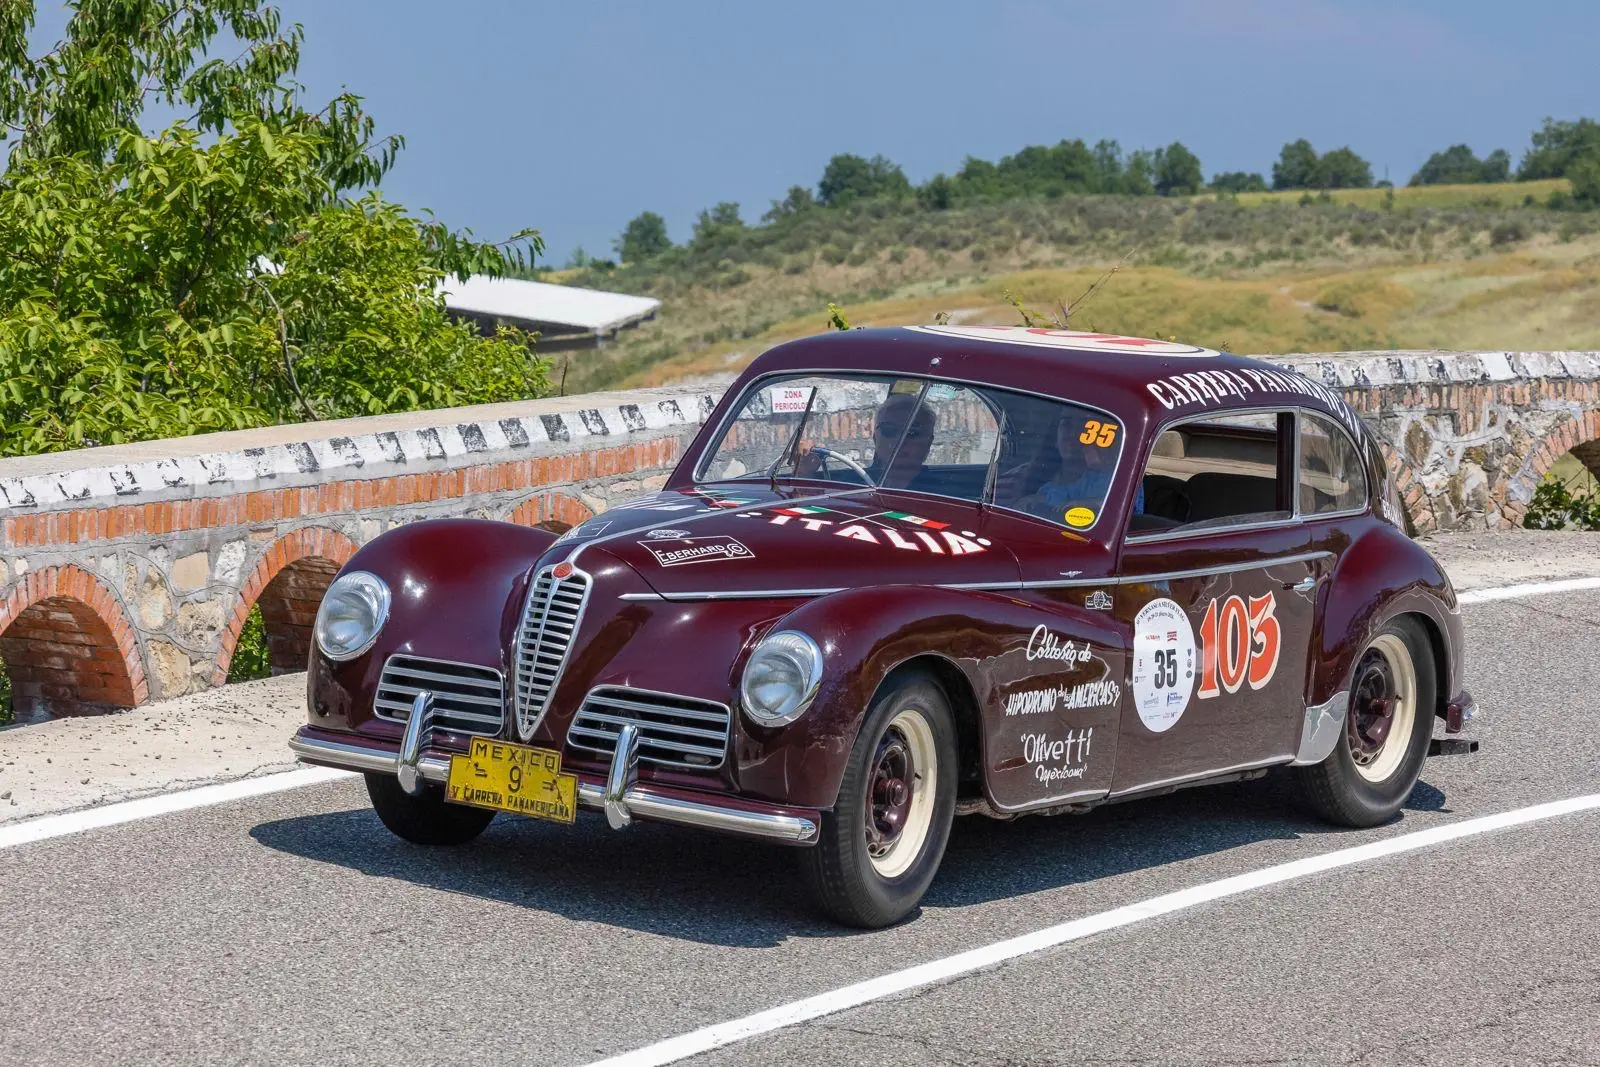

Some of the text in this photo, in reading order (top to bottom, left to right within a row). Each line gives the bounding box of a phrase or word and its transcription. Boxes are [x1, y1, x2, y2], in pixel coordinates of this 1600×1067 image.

[784, 390, 803, 399] ZONA
[1146, 368, 1253, 410] CARRERA
[1079, 420, 1118, 448] 35
[768, 515, 988, 556] ITALIA
[655, 545, 725, 562] EBERHARD
[1197, 590, 1281, 700] 103
[1154, 649, 1177, 689] 35
[476, 742, 555, 770] MEXICO
[507, 765, 522, 793] 9
[463, 785, 503, 806] CARRERA
[507, 795, 570, 819] PANAMERICANA
